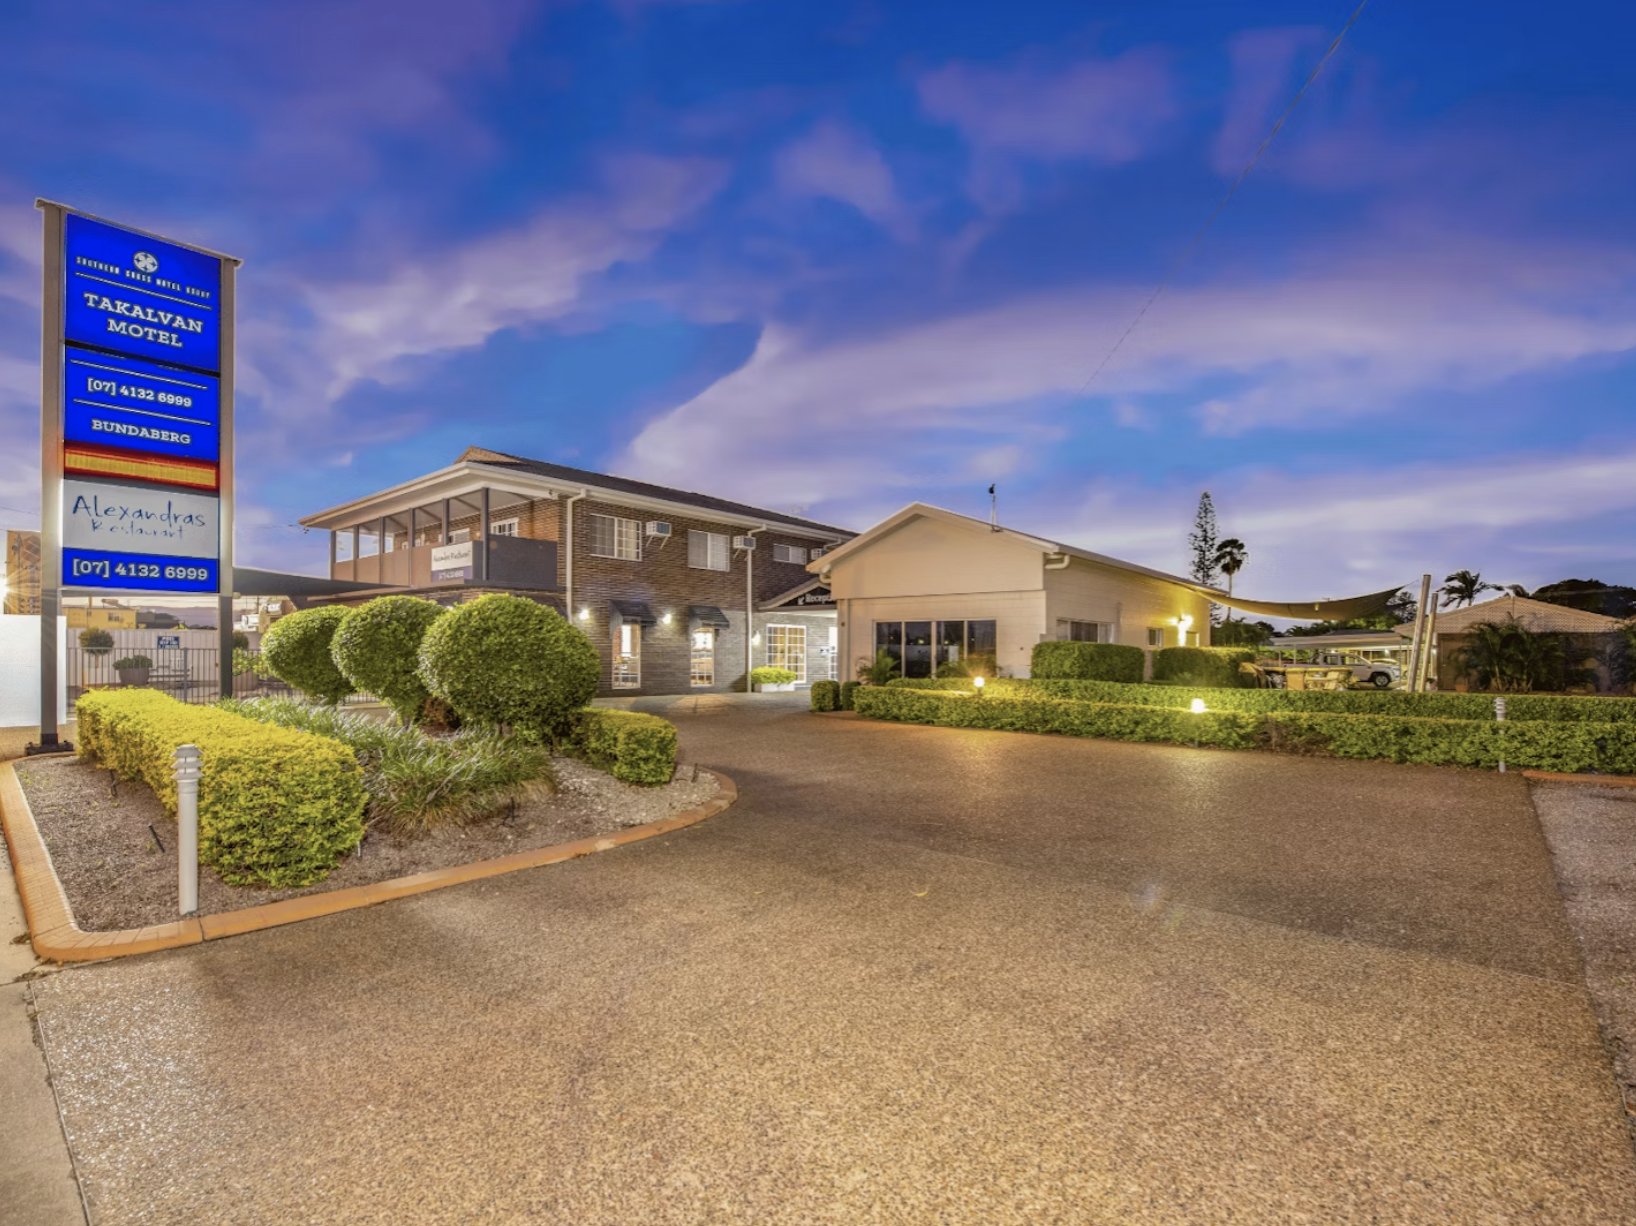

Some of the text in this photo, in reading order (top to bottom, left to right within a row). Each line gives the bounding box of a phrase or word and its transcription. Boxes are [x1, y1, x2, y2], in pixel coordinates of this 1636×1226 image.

[76, 256, 120, 274] SOUTHERN
[125, 270, 152, 283] CROSS
[155, 278, 181, 292] HOTEL
[83, 293, 204, 334] TAKALVAN
[107, 318, 183, 348] MOTEL
[87, 378, 193, 408] [07] 4132 6999
[91, 419, 192, 445] BUNDABERG
[72, 495, 206, 528] Alexandras
[72, 558, 208, 581] [07] 4132 6999
